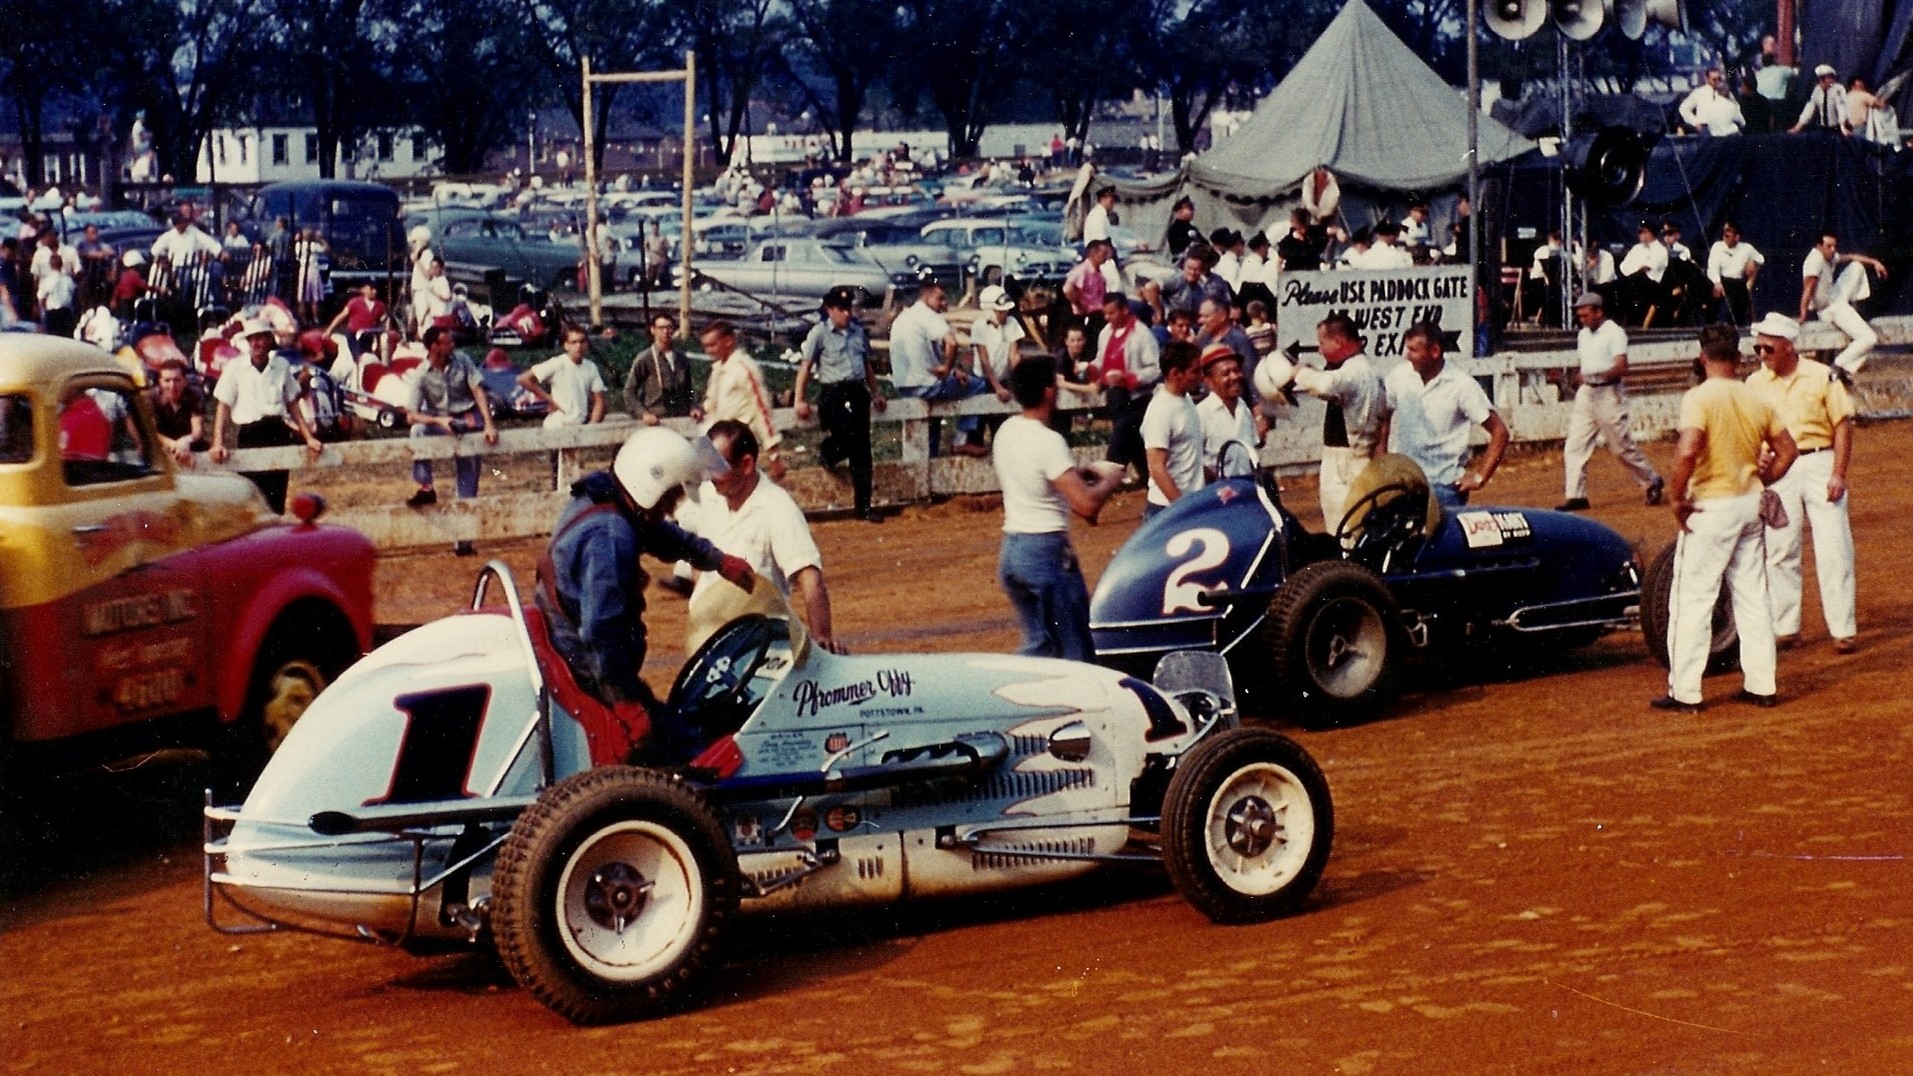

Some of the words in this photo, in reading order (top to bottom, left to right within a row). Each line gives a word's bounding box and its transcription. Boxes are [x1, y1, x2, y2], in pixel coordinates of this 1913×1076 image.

[1282, 279, 1338, 306] Please
[1340, 280, 1365, 303] USE
[1370, 278, 1430, 303] PADDOCK
[1433, 276, 1467, 299] GATE
[1354, 306, 1406, 330] WEST
[1374, 333, 1406, 357] EXI
[1163, 529, 1230, 615] 2
[792, 679, 876, 717] Pfrommer
[877, 669, 914, 698] Offy
[1118, 676, 1188, 743] 1
[361, 682, 492, 807] 1
